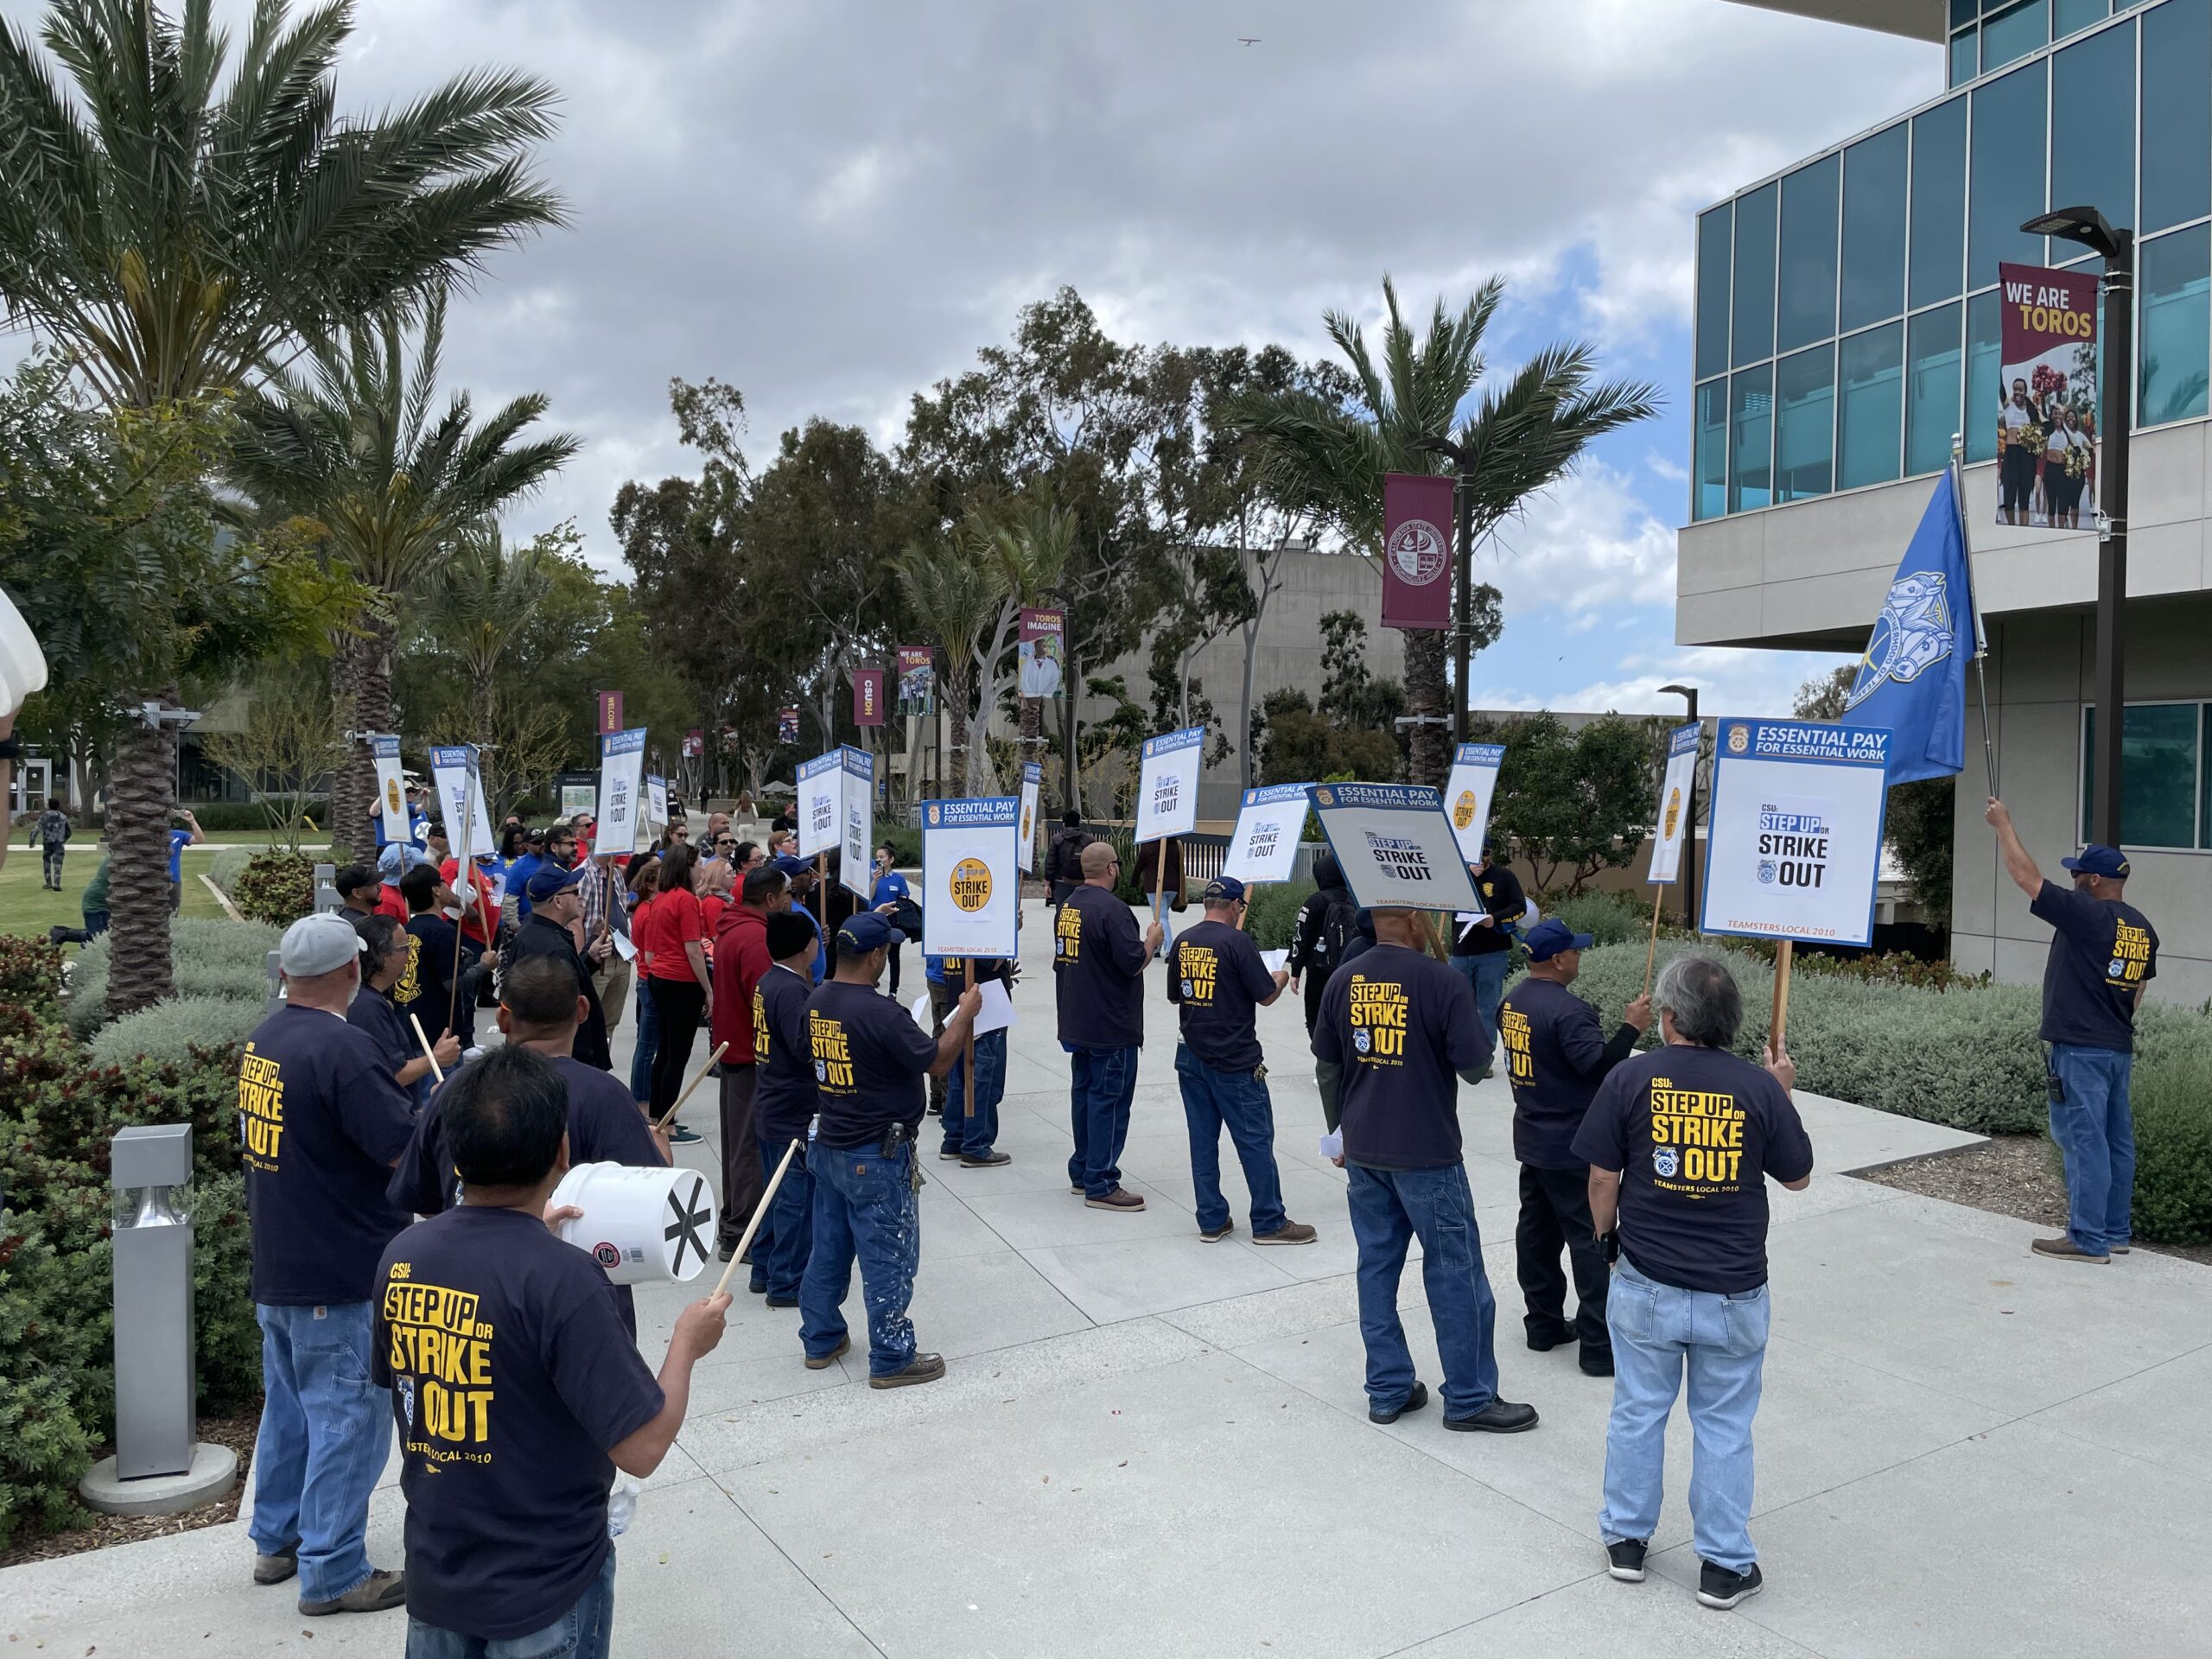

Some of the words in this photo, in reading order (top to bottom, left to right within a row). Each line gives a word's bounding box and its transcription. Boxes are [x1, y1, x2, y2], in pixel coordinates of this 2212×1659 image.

[2005, 283, 2032, 304] WE
[2037, 287, 2069, 309] ARE
[2019, 306, 2091, 338] TOROS
[1392, 524, 1413, 556] CALIFORNIA
[1395, 563, 1426, 582] DOMINGUEZ
[1427, 566, 1440, 579] HILLS
[1027, 622, 1061, 631] IMAGINE
[1035, 614, 1061, 623] TOROS
[612, 733, 632, 745] ESSENTIAL
[632, 732, 644, 741] PAY
[1156, 732, 1186, 747] ESSENTIAL
[1188, 729, 1202, 739] PAY
[1758, 727, 1848, 747] ESSENTIAL
[1852, 733, 1888, 749] PAY
[849, 751, 864, 766] ESSENTIAL
[1465, 747, 1491, 756] ESSENTIAL
[1756, 742, 1780, 753] FOR
[1783, 745, 1844, 758] ESSENTIAL
[1847, 748, 1885, 760] WORK
[808, 754, 833, 770] ESSENTIAL
[611, 793, 626, 806] STRIKE
[1154, 785, 1179, 800] STRIKE
[1259, 786, 1296, 797] ESSENTIAL
[1337, 787, 1407, 799] ESSENTIAL
[1409, 790, 1434, 800] PAY
[944, 803, 994, 814] ESSENTIAL
[995, 802, 1015, 812] PAY
[1161, 798, 1177, 813] OUT
[1357, 797, 1407, 806] ESSENTIAL
[1762, 804, 1778, 812] CSU:
[614, 807, 625, 823] OUT
[813, 804, 831, 820] STRIKE
[1456, 807, 1472, 817] STRIKE
[818, 816, 831, 830] OUT
[1253, 824, 1268, 834] STEP
[1458, 818, 1467, 827] OUT
[1761, 813, 1797, 831] STEP
[1799, 817, 1821, 833] UP
[849, 824, 861, 842] STRIKE
[1249, 833, 1279, 845] STRIKE
[852, 841, 861, 861] OUT
[1255, 844, 1275, 857] OUT
[1369, 837, 1395, 849] STEP
[1396, 840, 1414, 849] UP
[1758, 834, 1828, 859] STRIKE
[1373, 849, 1427, 864] STRIKE
[1396, 866, 1433, 880] OUT
[1779, 861, 1826, 888] OUT
[955, 881, 987, 894] STRIKE
[962, 895, 980, 907] OUT
[1058, 921, 1080, 938] STRIKE
[1728, 919, 1781, 932] TEAMSTERS
[1782, 925, 1810, 935] LOCAL
[1813, 927, 1835, 937] 2010
[2118, 926, 2135, 940] STEP
[1066, 938, 1079, 957] OUT
[1179, 949, 1198, 960] STEP
[1199, 949, 1212, 961] UP
[2113, 940, 2150, 961] STRIKE
[1351, 985, 1381, 1001] STEP
[1383, 985, 1399, 1001] UP
[1401, 995, 1408, 1004] OR
[1351, 1003, 1407, 1027] STRIKE
[1503, 1012, 1517, 1027] STEP
[810, 1020, 830, 1036] STEP
[830, 1023, 840, 1038] UP
[811, 1037, 851, 1061] STRIKE
[1374, 1027, 1406, 1055] OUT
[241, 1055, 263, 1082] STEP
[263, 1060, 278, 1087] UP
[276, 1082, 284, 1092] OR
[827, 1061, 854, 1086] OUT
[1652, 1077, 1673, 1088] CSU:
[238, 1080, 283, 1122] STRIKE
[1653, 1092, 1700, 1114] STEP
[1705, 1096, 1732, 1118] UP
[1734, 1110, 1745, 1120] OR
[248, 1116, 283, 1158] OUT
[1652, 1115, 1743, 1147] STRIKE
[1685, 1147, 1742, 1182] OUT
[1654, 1179, 1694, 1192] TEAMSTERS
[391, 1262, 412, 1279] CSU:
[385, 1286, 440, 1323] STEP
[443, 1292, 475, 1332] UP
[479, 1322, 493, 1339] OR
[391, 1323, 493, 1385] STRIKE
[423, 1381, 493, 1442] OUT
[431, 1448, 461, 1462] LOCAL
[465, 1452, 492, 1464] 2010
